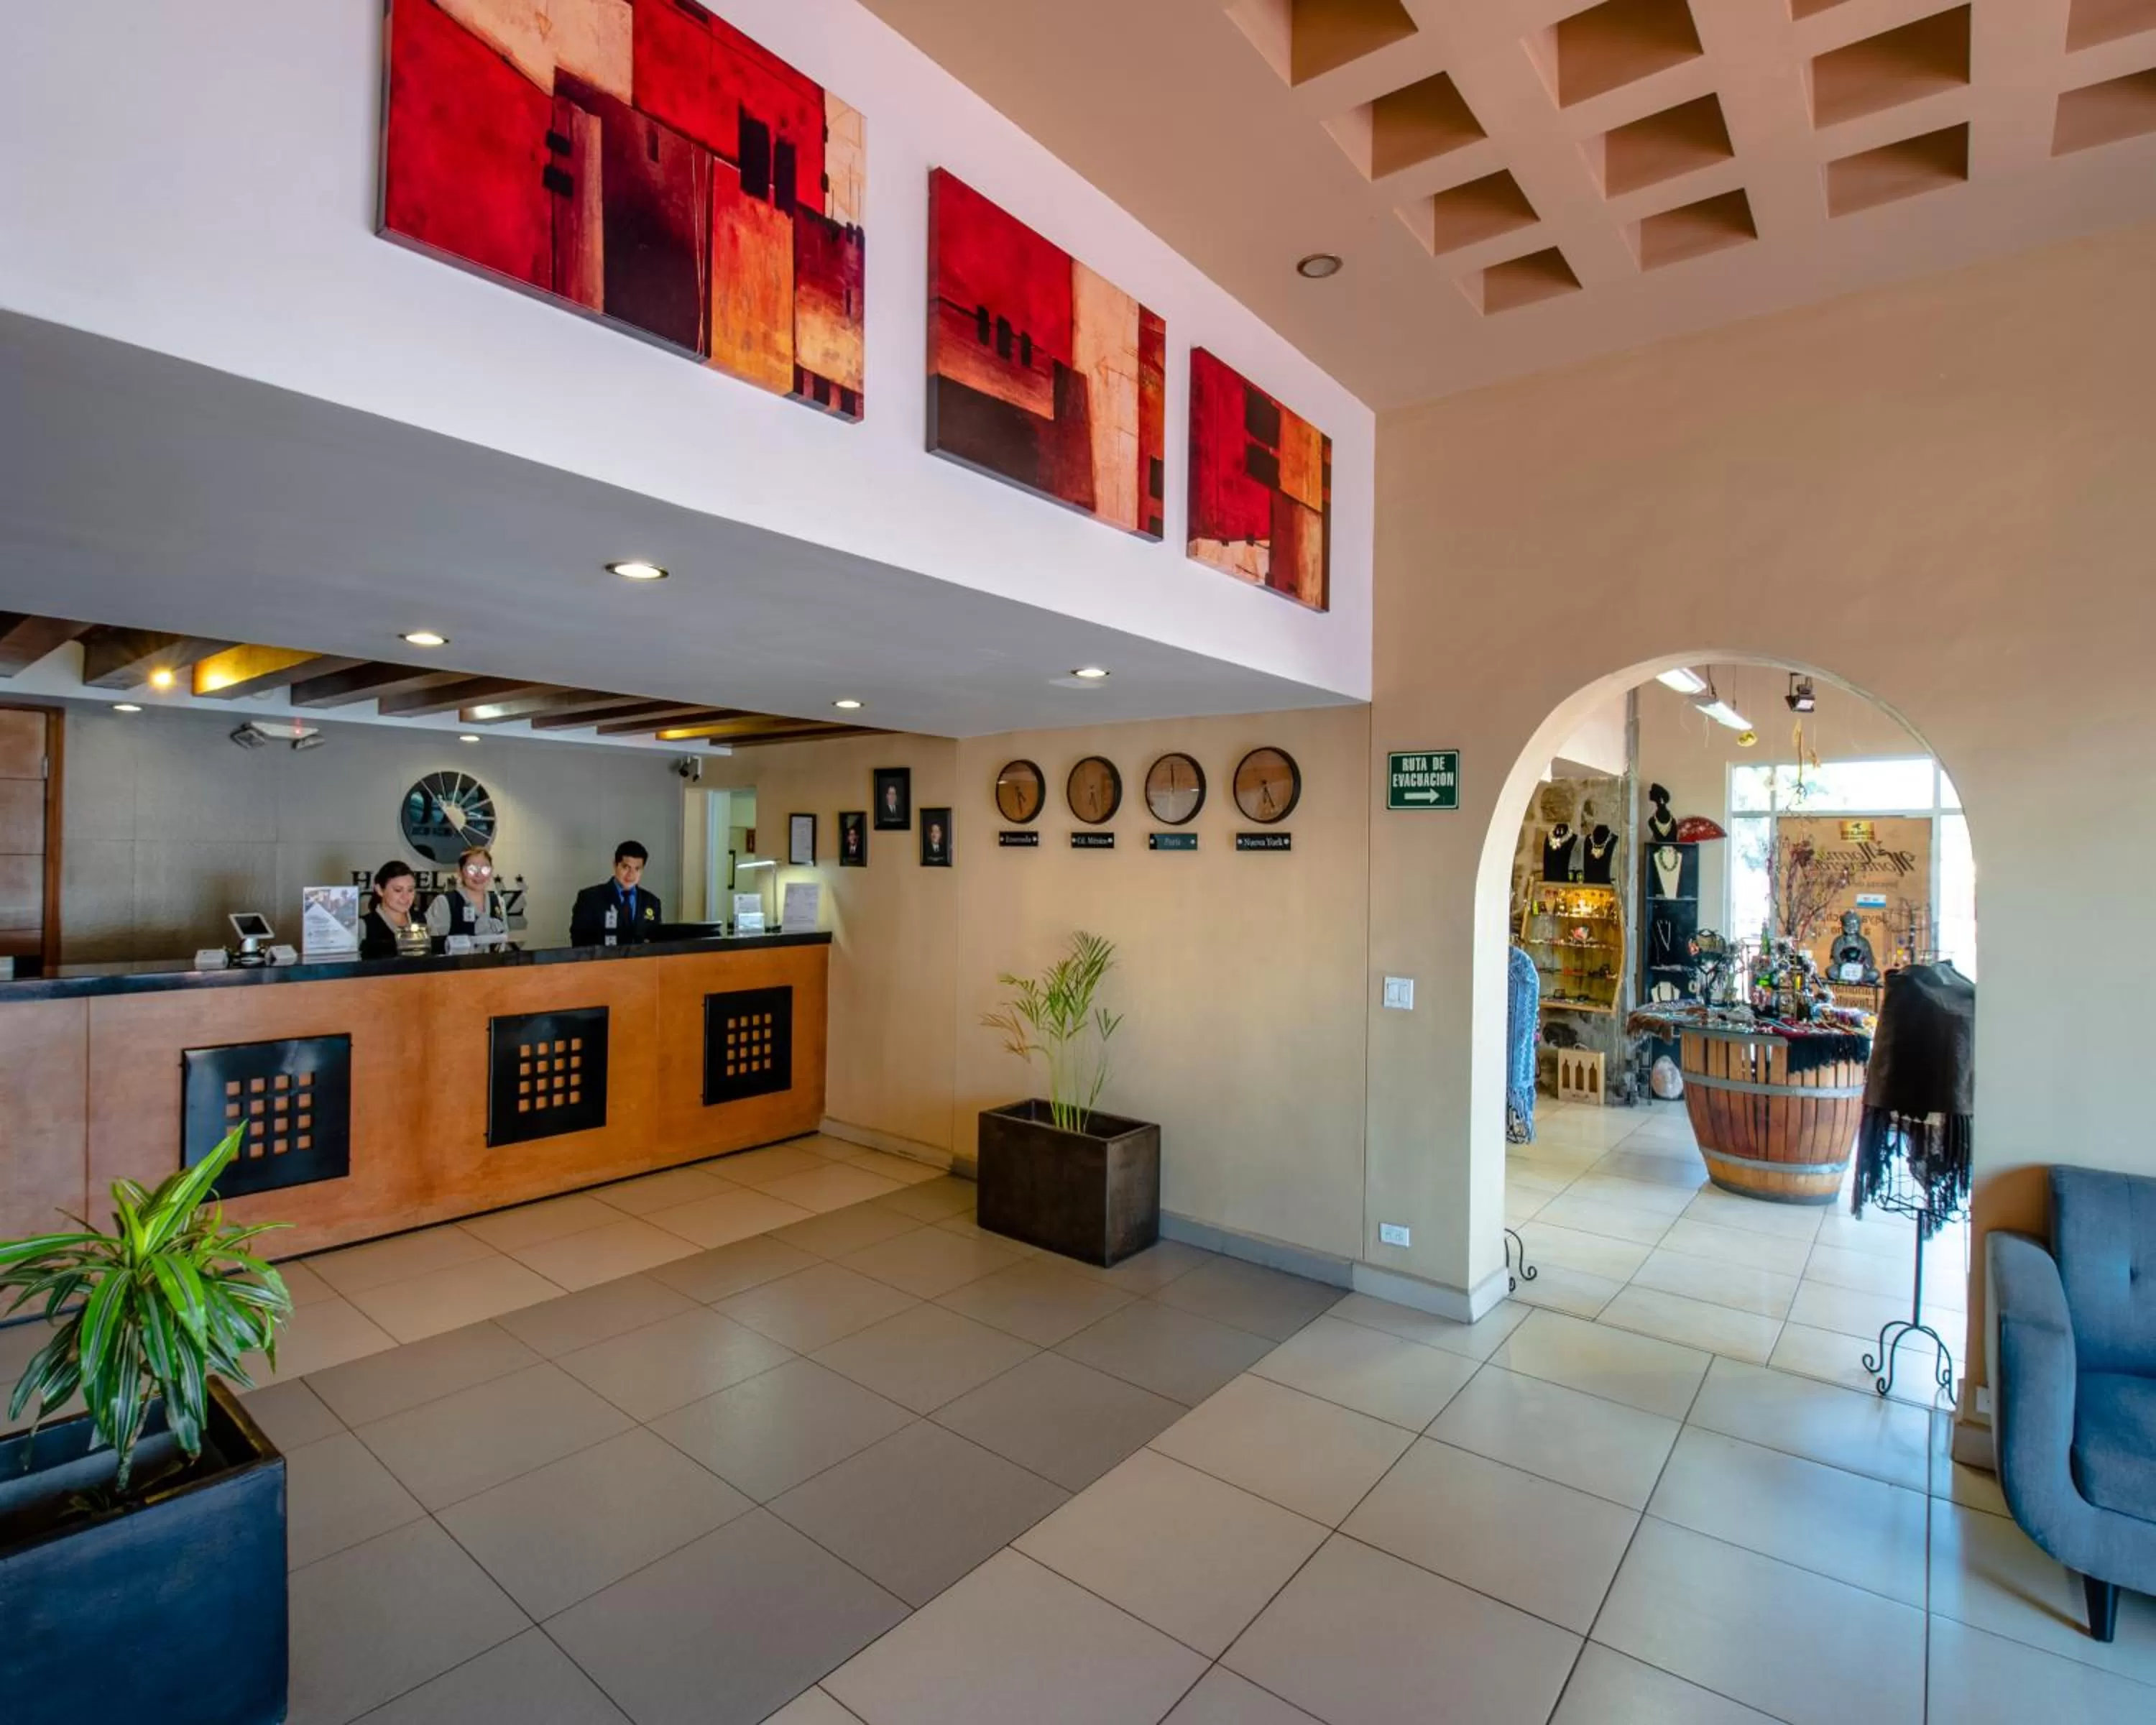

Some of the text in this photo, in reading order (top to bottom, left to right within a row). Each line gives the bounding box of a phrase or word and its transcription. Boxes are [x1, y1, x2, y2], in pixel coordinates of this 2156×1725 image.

[1402, 756, 1445, 771] RUTA DE
[1393, 772, 1454, 788] EVACUACION
[351, 871, 446, 890] HEL
